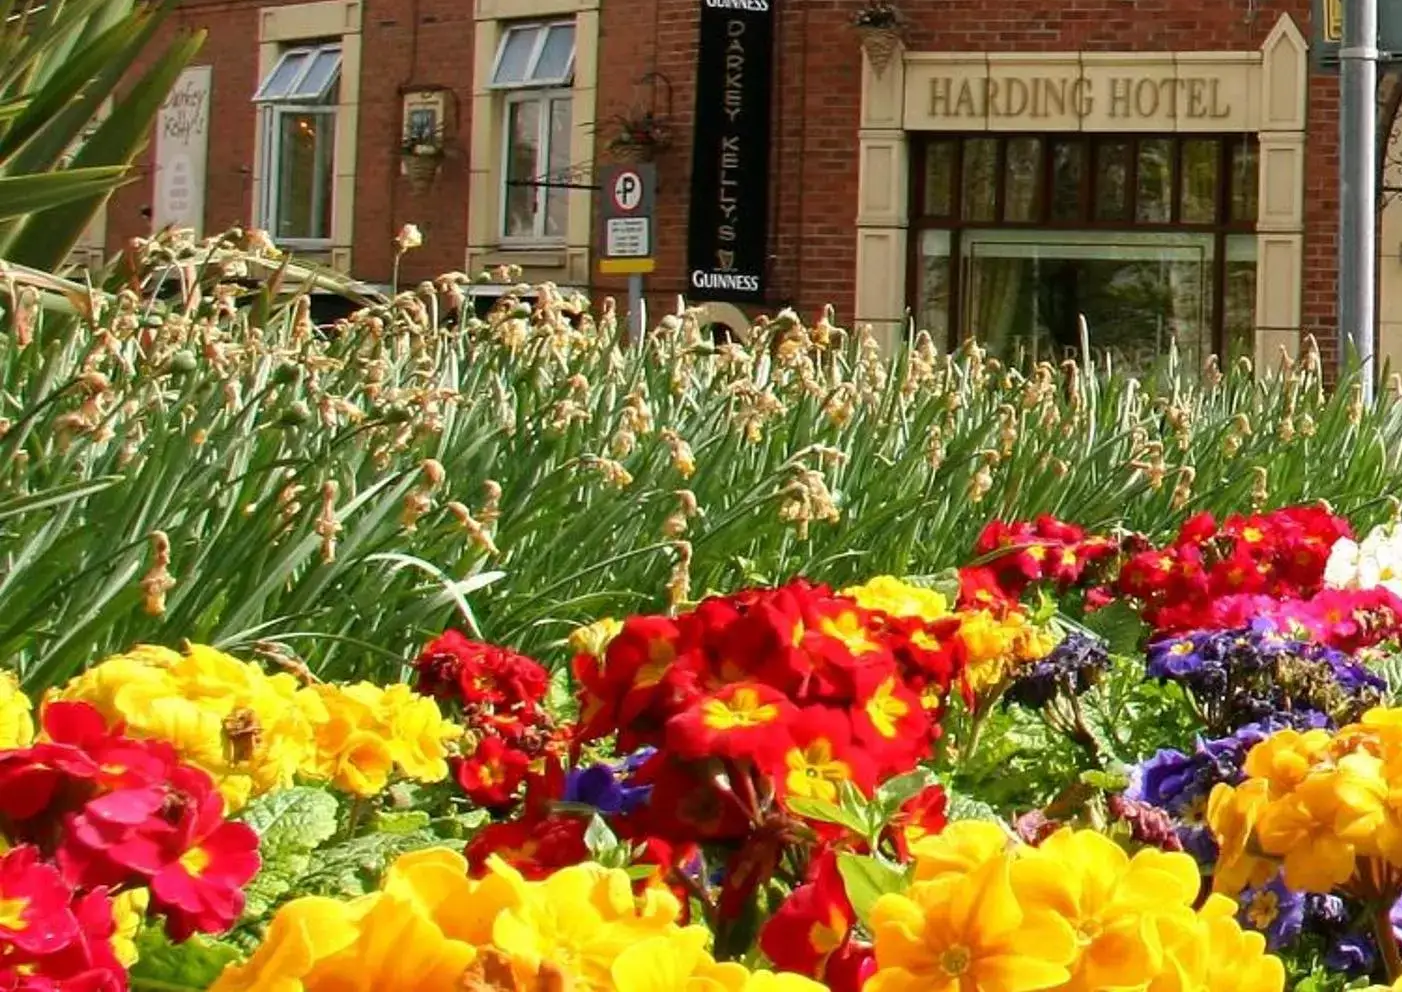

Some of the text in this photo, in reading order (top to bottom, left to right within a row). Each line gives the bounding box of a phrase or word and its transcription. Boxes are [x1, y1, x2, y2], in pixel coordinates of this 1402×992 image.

[723, 19, 745, 122] DARKEY
[926, 77, 1232, 119] HARDING HOTEL
[692, 269, 760, 292] GUINNESS
